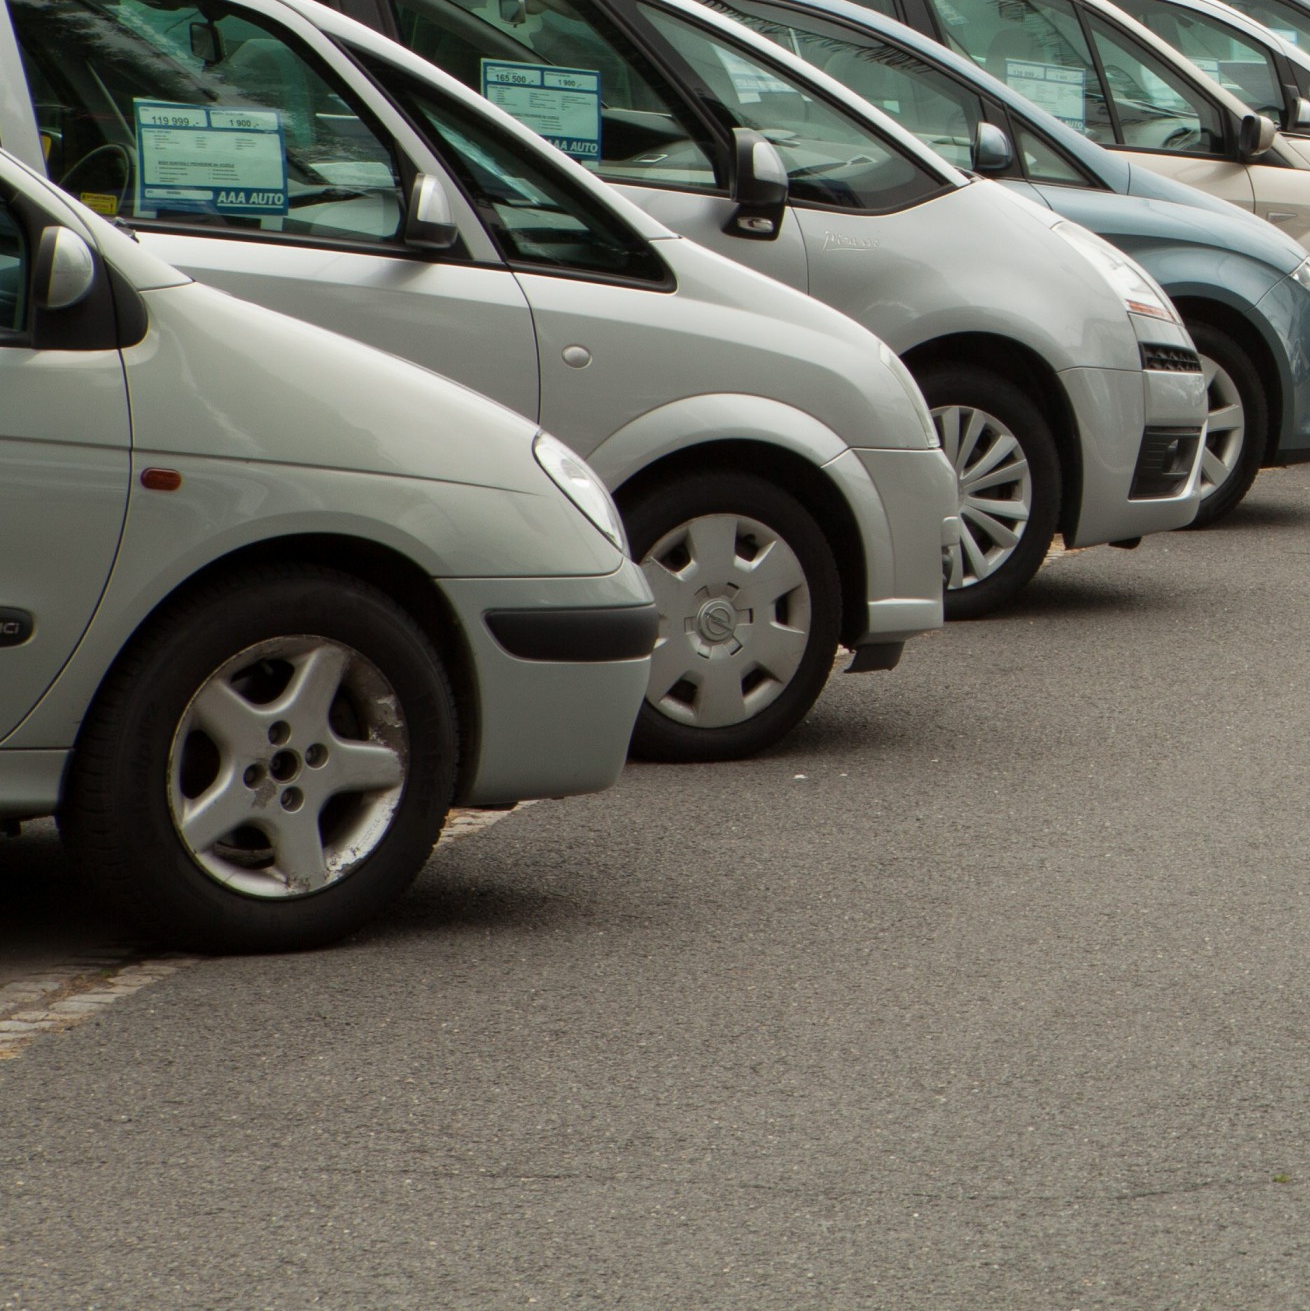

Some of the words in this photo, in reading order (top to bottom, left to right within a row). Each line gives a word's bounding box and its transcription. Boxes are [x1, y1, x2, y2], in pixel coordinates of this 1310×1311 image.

[495, 74, 510, 82] 165
[512, 75, 526, 83] 500
[152, 116, 169, 125] 119
[171, 117, 189, 126] 999
[570, 143, 598, 153] AUTO
[217, 191, 246, 203] AAA
[249, 193, 284, 205] AUTO
